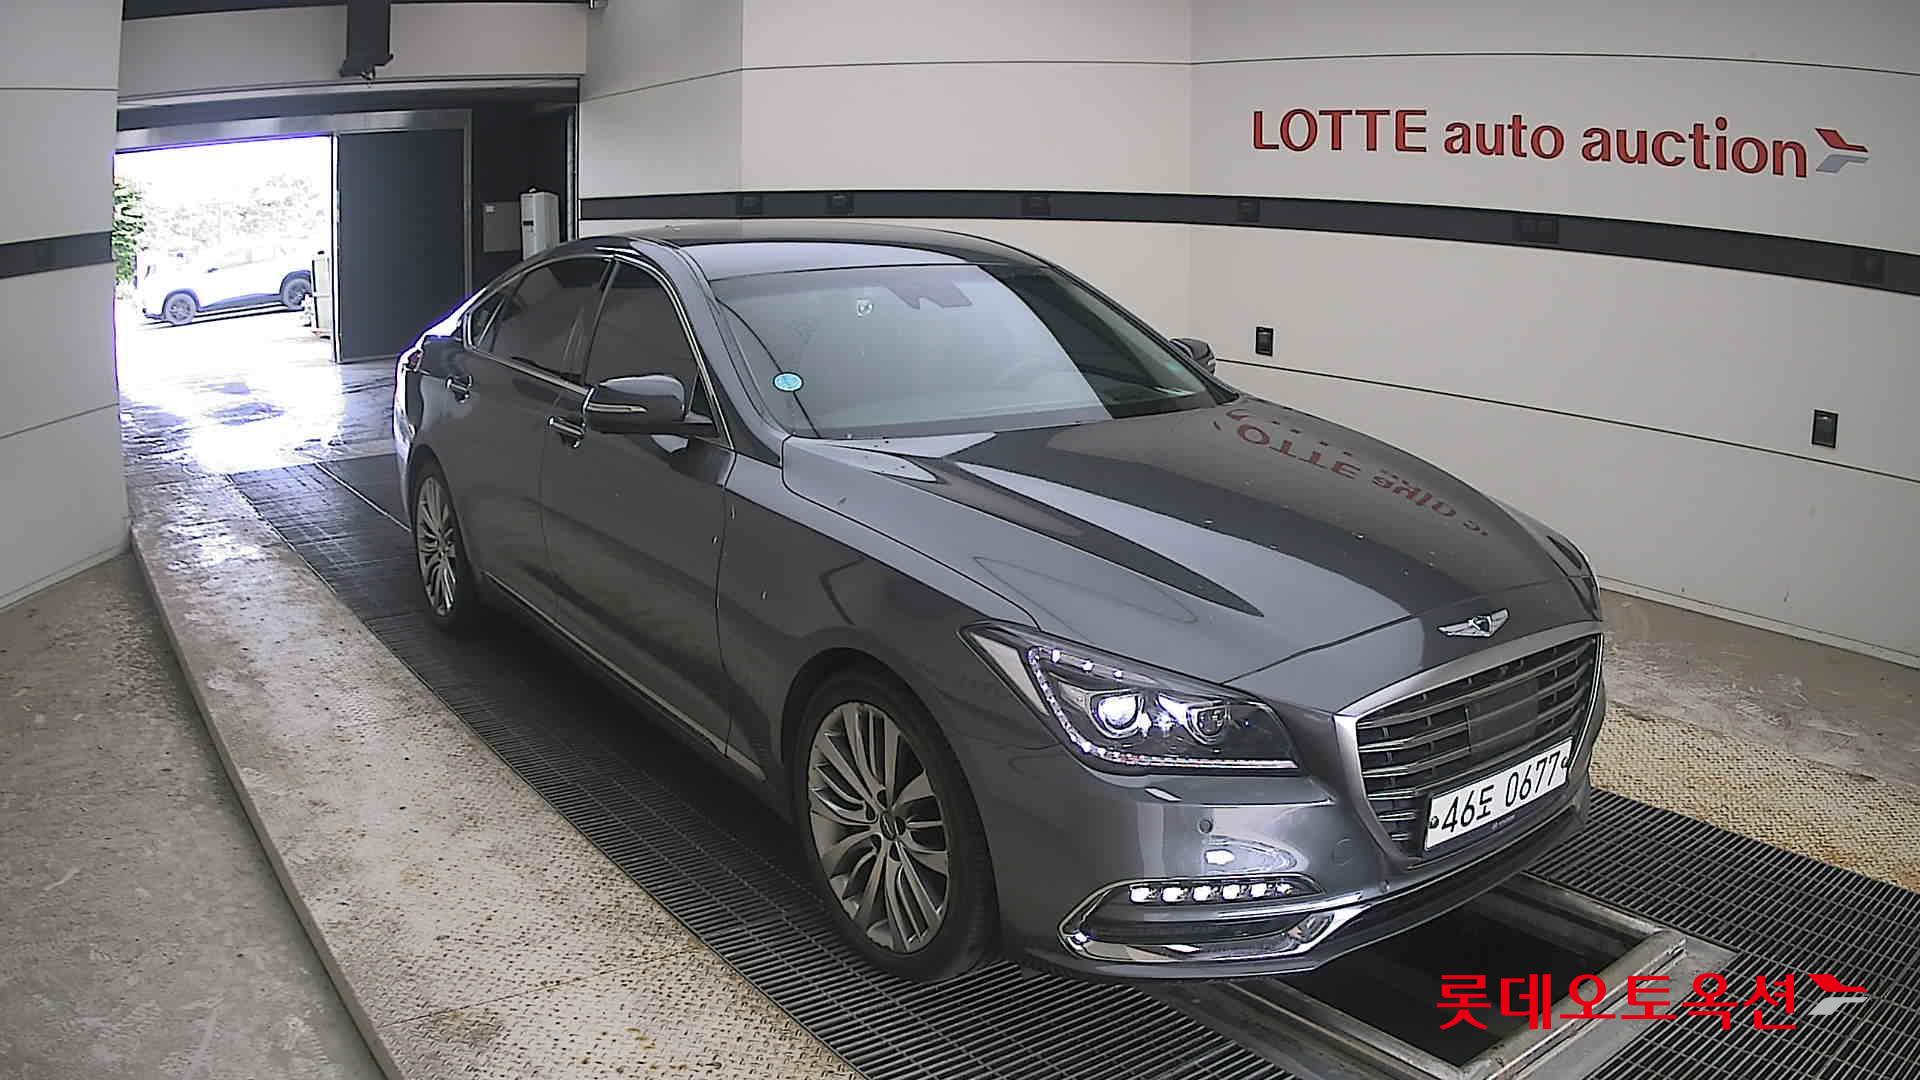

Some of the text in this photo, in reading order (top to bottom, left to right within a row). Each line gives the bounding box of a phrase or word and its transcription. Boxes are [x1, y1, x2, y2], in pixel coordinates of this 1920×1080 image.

[1251, 107, 1808, 179] LOTTE auto auction
[1441, 751, 1561, 833] 46도 0677
